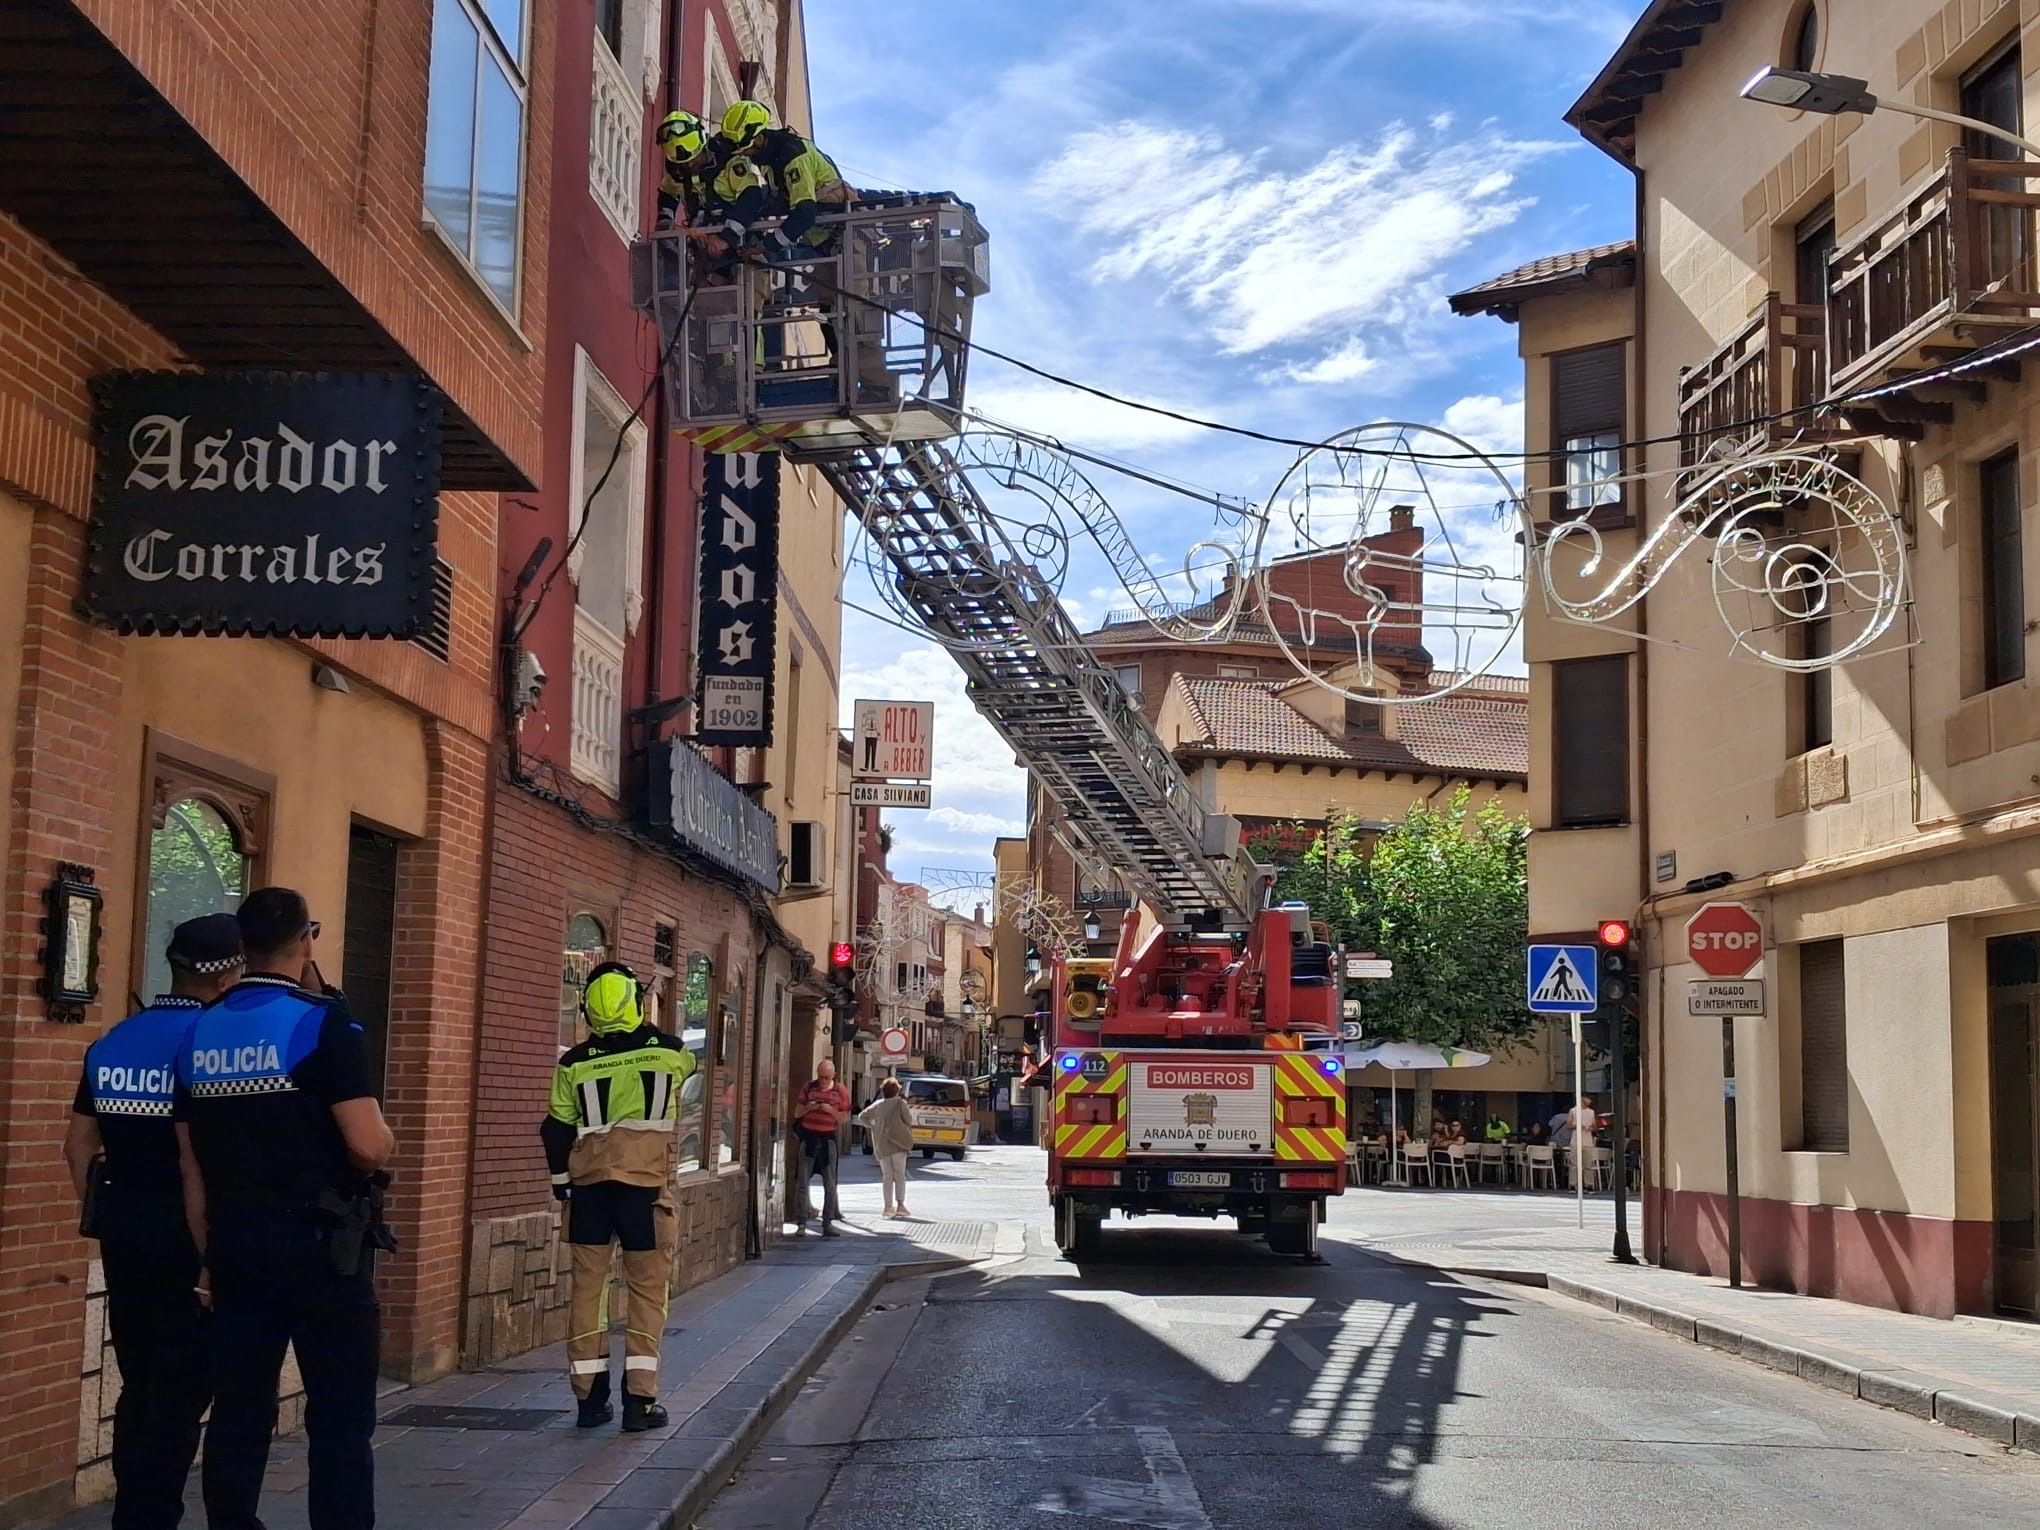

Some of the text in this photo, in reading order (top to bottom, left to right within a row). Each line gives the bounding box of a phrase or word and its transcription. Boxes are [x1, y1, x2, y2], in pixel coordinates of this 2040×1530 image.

[124, 414, 398, 495] Asador
[124, 528, 387, 586] Corrales
[725, 695, 741, 705] en
[709, 709, 758, 727] 1902
[884, 707, 918, 743] ALTO
[893, 747, 924, 773] BEBER
[854, 787, 926, 803] CASA SILVIANO
[1691, 932, 1759, 950] STOP
[1708, 986, 1744, 996] APAGADO
[1695, 1000, 1759, 1009] O INTERMITENTE
[193, 1039, 280, 1075] POLICÍA
[593, 1061, 623, 1070] ARANDA
[635, 1055, 661, 1063] DUERO
[1084, 1060, 1106, 1072] 112
[1152, 1071, 1249, 1085] BOMBEROS
[1143, 1128, 1257, 1140] ARANDA DE DUERO
[1174, 1173, 1227, 1184] 0503 GJY
